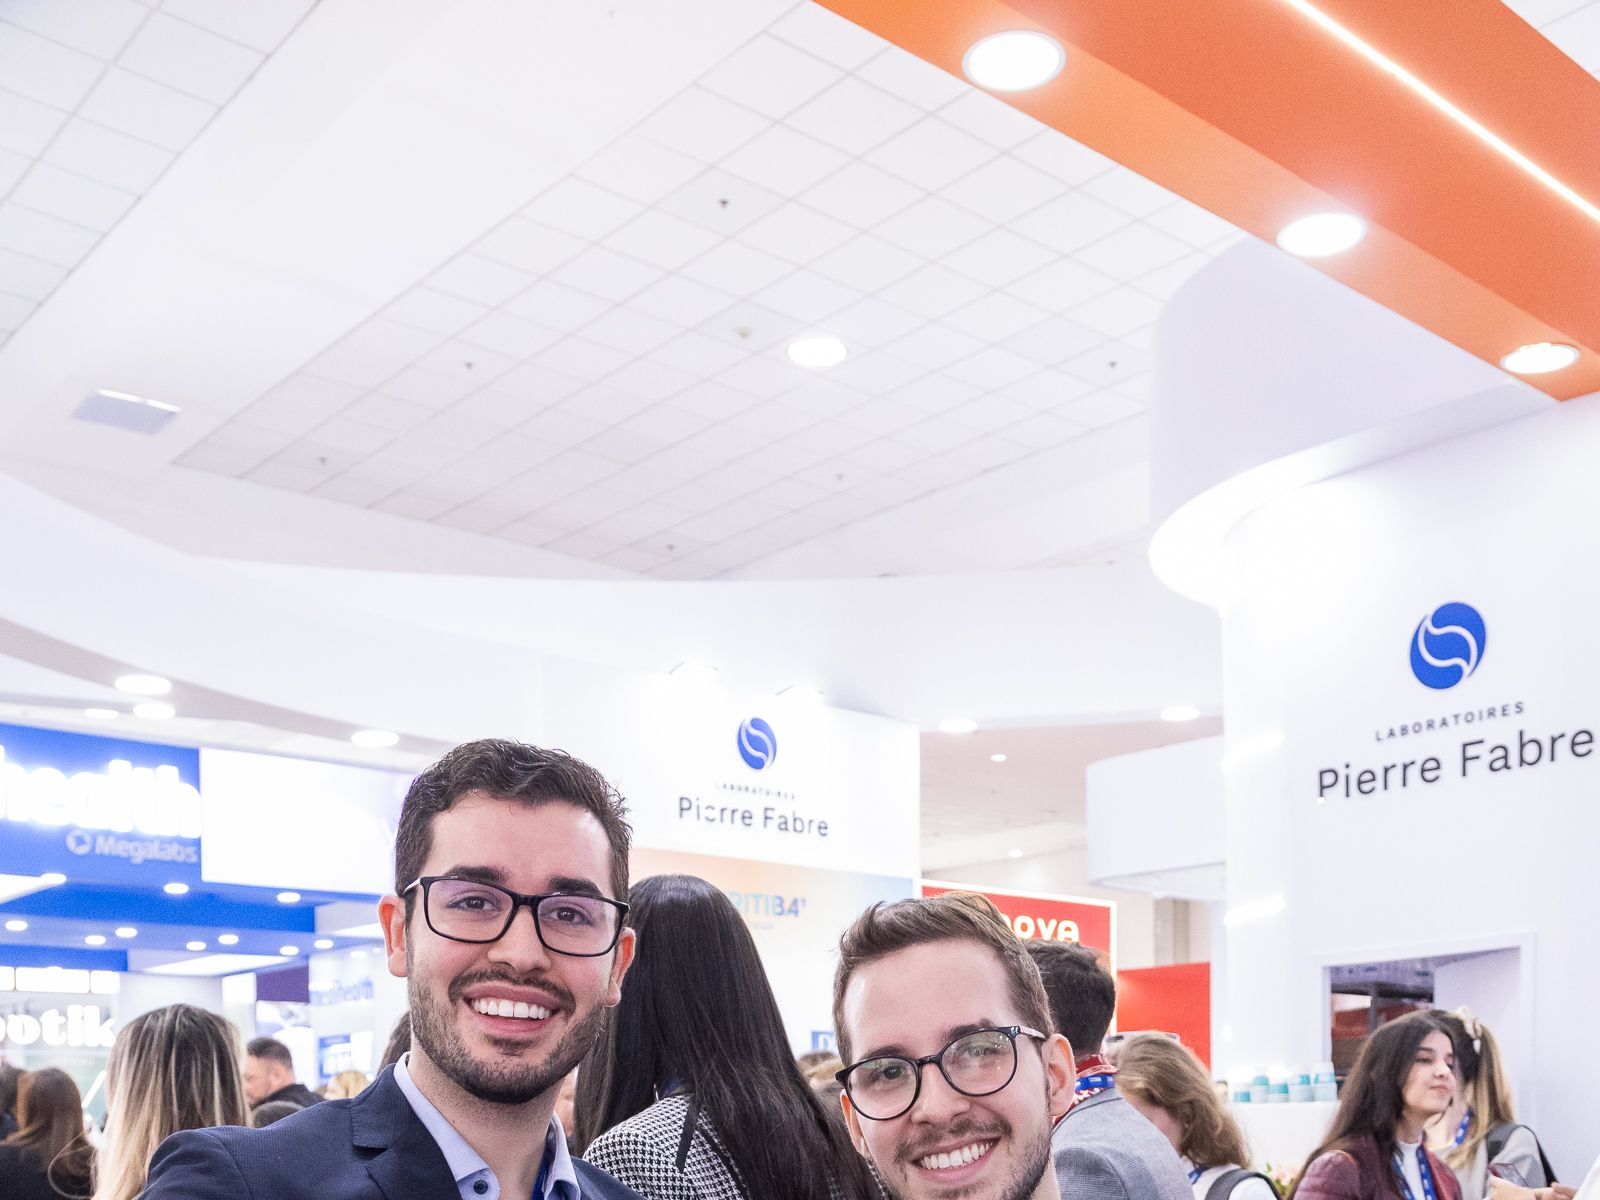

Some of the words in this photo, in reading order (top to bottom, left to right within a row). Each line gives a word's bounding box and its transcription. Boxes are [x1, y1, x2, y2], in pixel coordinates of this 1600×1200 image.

[1375, 701, 1525, 742] LABORATOIRES
[1318, 756, 1442, 799] Pierre
[1461, 728, 1595, 778] Fabre
[763, 806, 829, 838] Fabre
[95, 834, 198, 865] Megalabs
